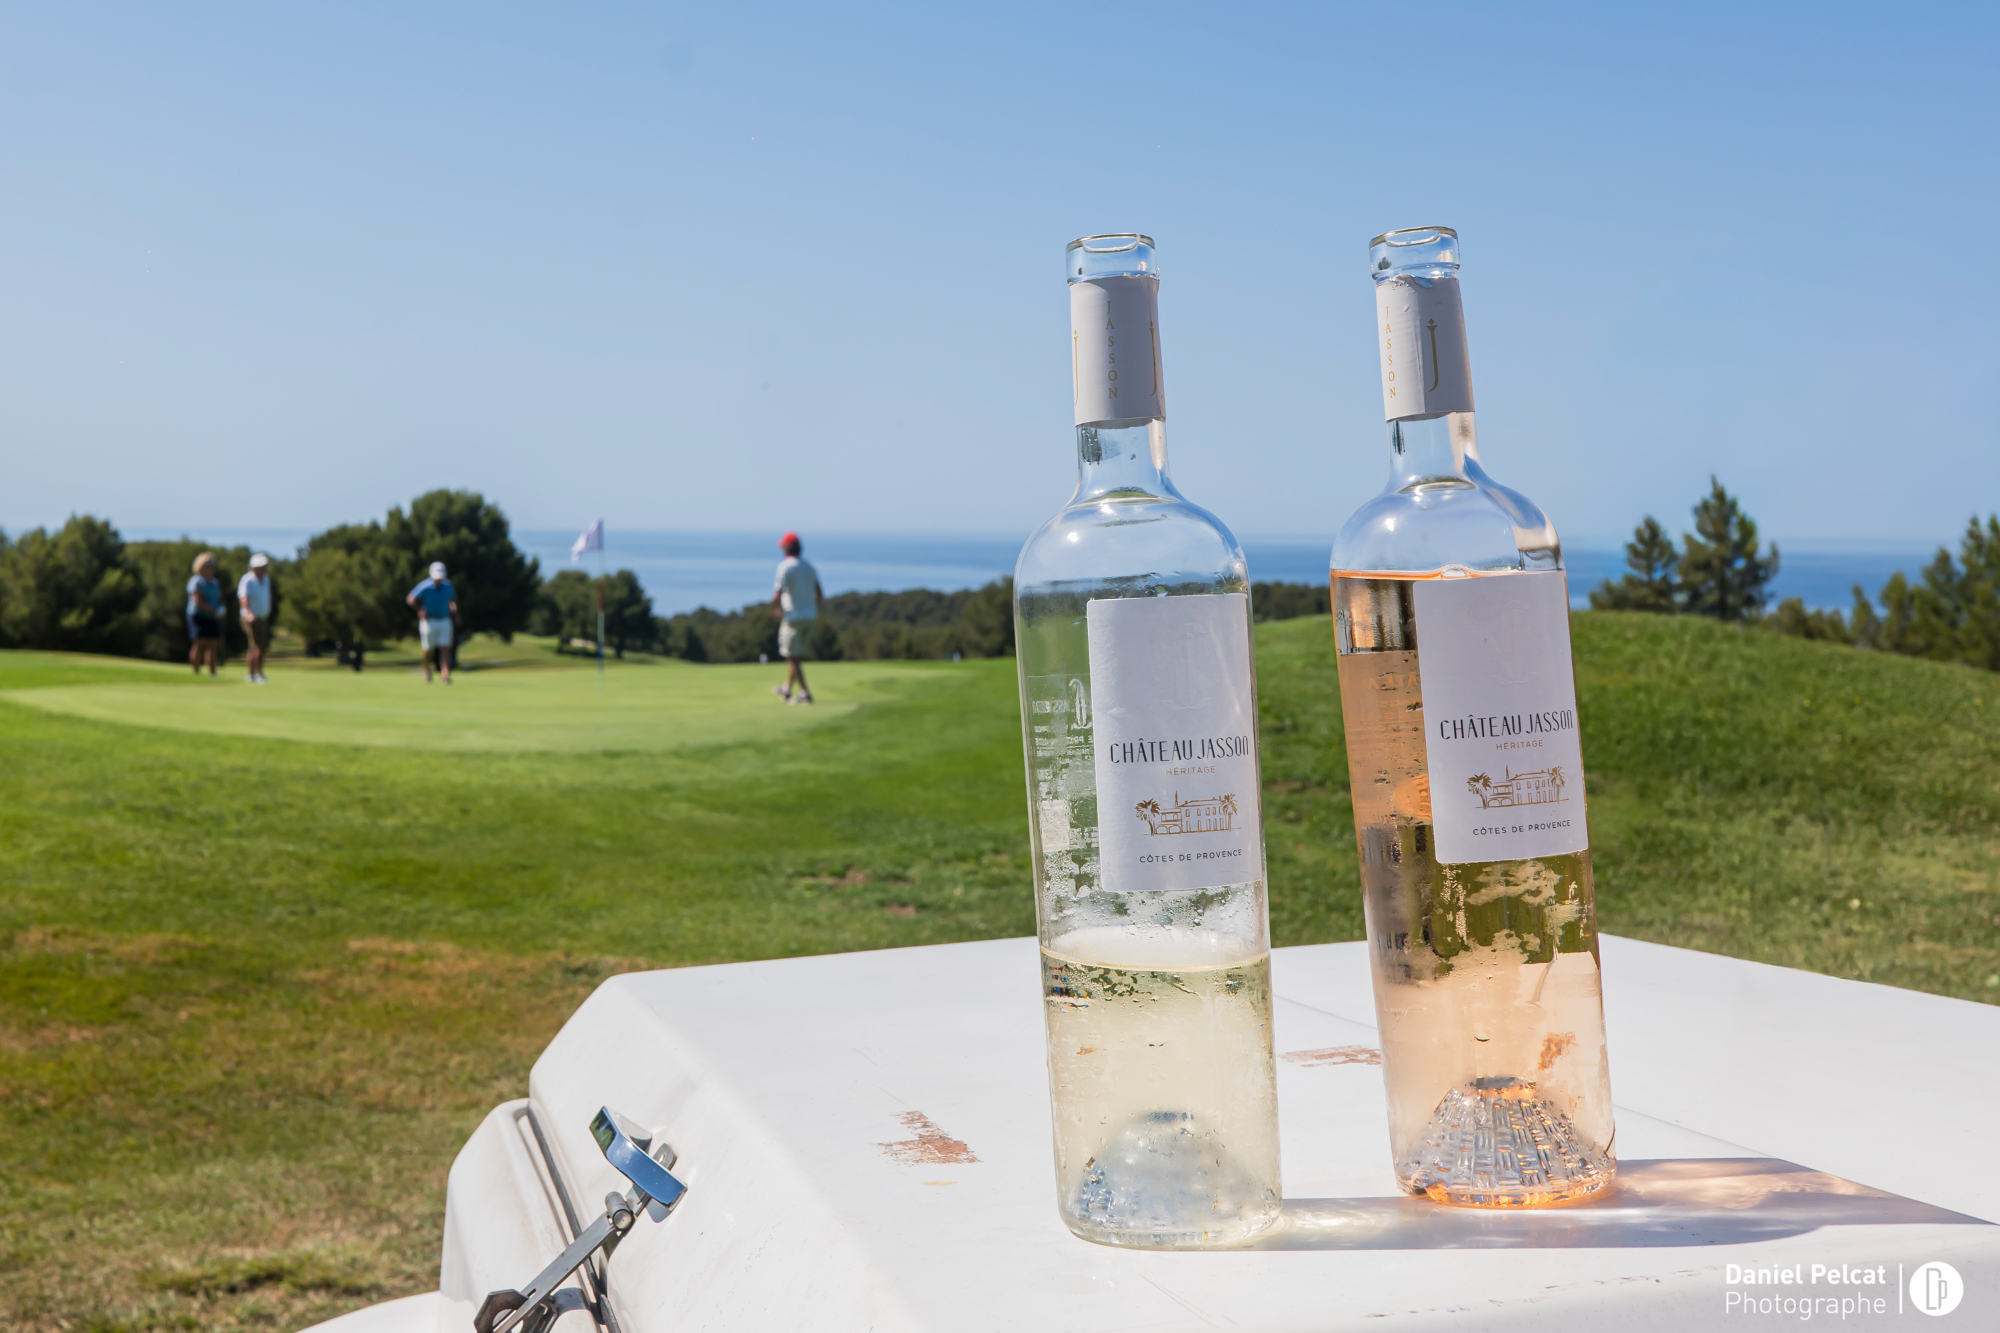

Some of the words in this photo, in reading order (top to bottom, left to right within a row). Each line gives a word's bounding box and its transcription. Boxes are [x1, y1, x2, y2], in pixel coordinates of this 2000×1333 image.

[1105, 300, 1119, 400] JASSON
[1385, 306, 1397, 399] JASSON
[1440, 714, 1522, 740] CHÂTEAU
[1110, 737, 1193, 764] CHÂTEAU
[1495, 739, 1544, 751] HÉRITAGE
[1165, 765, 1216, 776] HÉRITAGE
[1472, 826, 1507, 836] CÔTES
[1511, 825, 1524, 833] DE
[1528, 819, 1571, 832] PROVENCE
[1139, 854, 1174, 864] CÔTES
[1179, 853, 1192, 862] DE
[1196, 848, 1242, 861] PROVENCE
